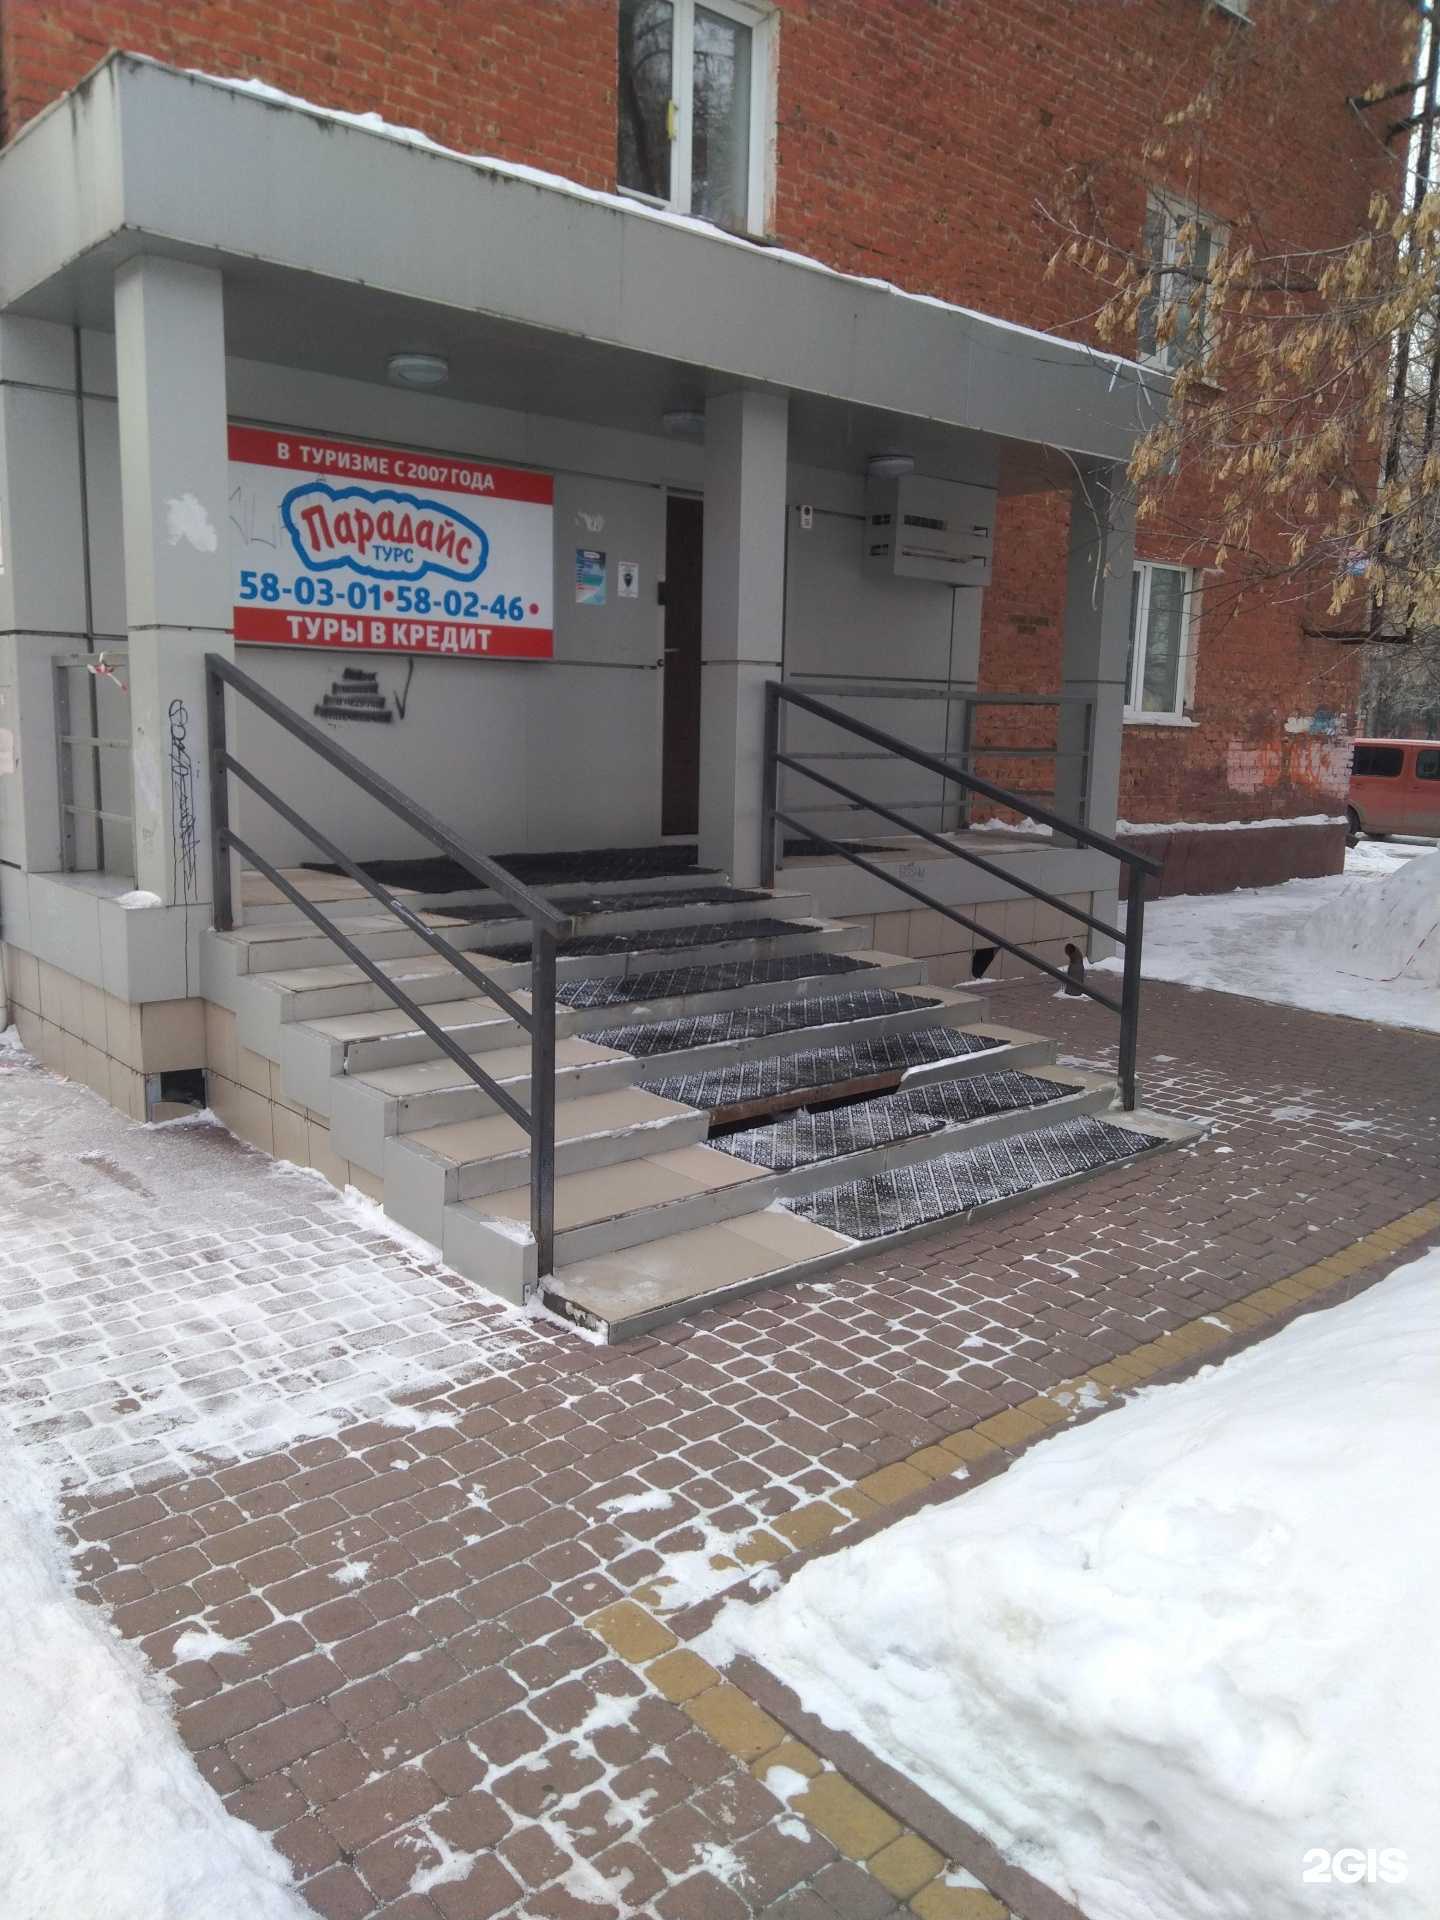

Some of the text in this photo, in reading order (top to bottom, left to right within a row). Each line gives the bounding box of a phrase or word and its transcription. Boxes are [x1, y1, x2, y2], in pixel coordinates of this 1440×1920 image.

[277, 442, 495, 491] В ТУРИЗМЕ С 2007 ГОДА
[301, 504, 472, 565] Парадайс
[372, 545, 414, 563] ТУРС
[286, 615, 492, 653] ТУРЫ В КРЕДИТ
